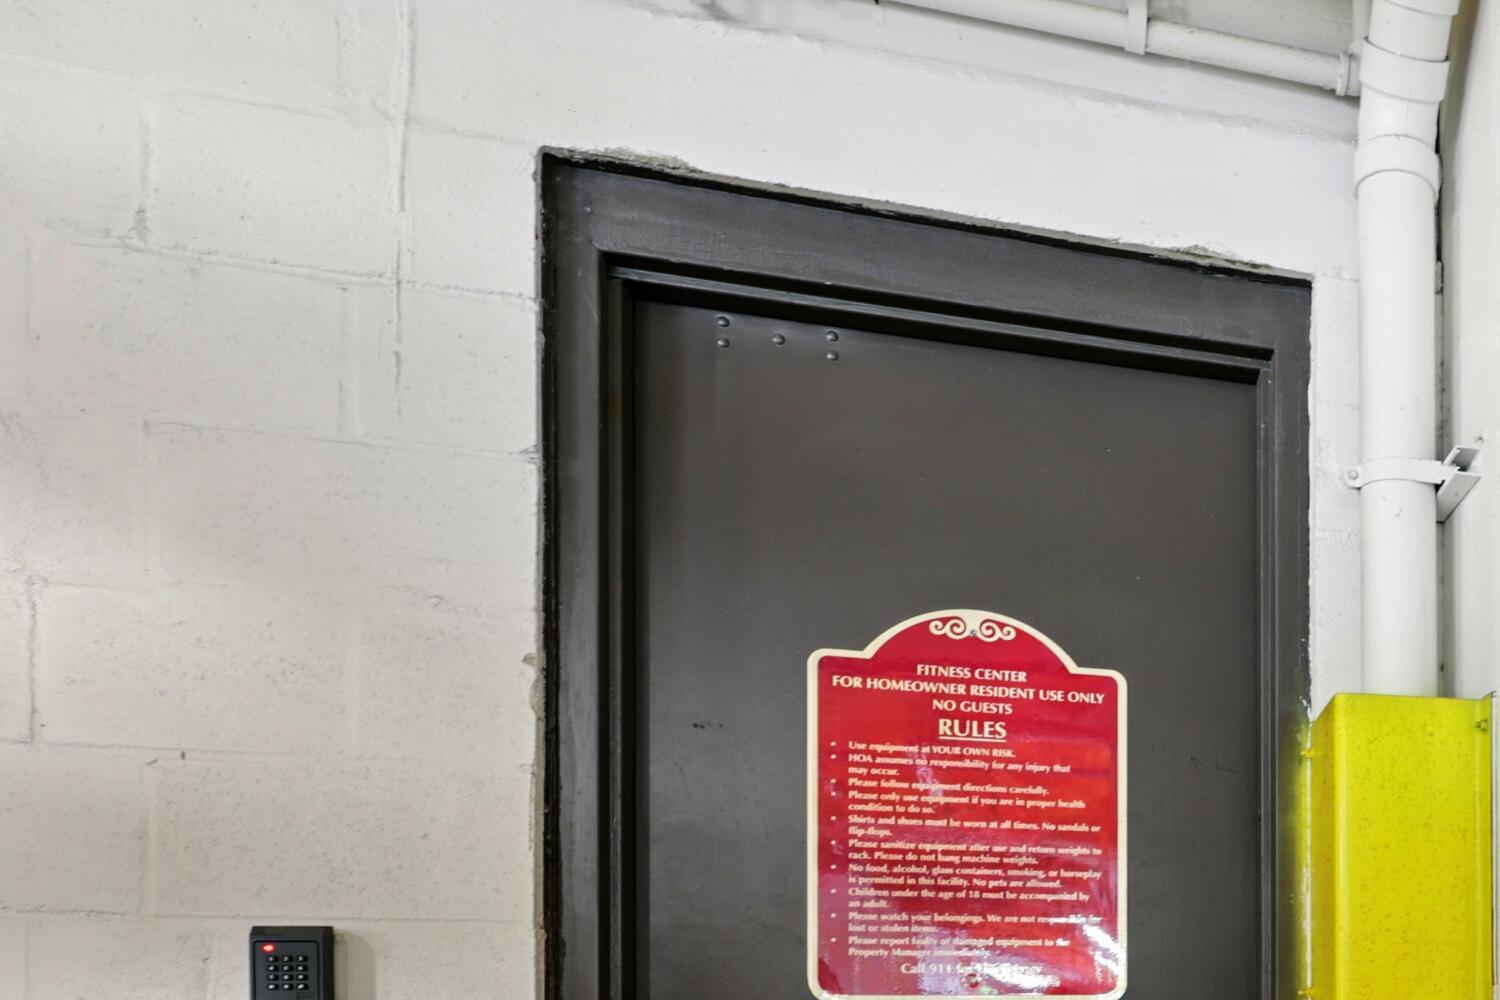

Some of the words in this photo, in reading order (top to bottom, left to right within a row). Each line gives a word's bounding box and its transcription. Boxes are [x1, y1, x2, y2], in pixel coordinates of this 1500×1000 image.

[917, 664, 971, 679] FITNESS
[975, 668, 1027, 682] CENTER
[832, 675, 863, 688] FOR
[866, 678, 966, 695] HOMEOWNER
[970, 684, 1035, 700] RESIDENT
[1040, 689, 1064, 701] USE
[1067, 691, 1104, 704] ONLY
[932, 700, 956, 712] NO
[960, 701, 1012, 715] GUESTS
[939, 719, 1007, 739] RULES
[848, 741, 866, 749] Use
[869, 743, 918, 753] equipment
[932, 746, 961, 754] YOUR
[963, 747, 989, 756] OWN
[992, 748, 1015, 757] RISK.
[848, 754, 872, 762] HOA
[875, 756, 913, 764] assumes
[929, 759, 989, 770] responsibility
[992, 761, 1004, 769] for
[1007, 763, 1023, 772] any
[1025, 762, 1050, 773] injury
[1053, 764, 1070, 772] that
[848, 768, 867, 776] may
[848, 778, 878, 786] Please
[881, 779, 909, 788] follow
[912, 782, 961, 791] equipment
[962, 783, 1006, 792] directions
[848, 791, 878, 799] Please
[880, 792, 899, 802] only
[921, 794, 969, 804] equipment
[980, 798, 996, 806] you
[1016, 798, 1024, 806] in
[1026, 800, 1056, 808] proper
[1058, 800, 1085, 808] health
[848, 803, 893, 811] condition
[848, 815, 875, 824] Shirts
[877, 816, 895, 824] and
[898, 817, 922, 825] shoes
[925, 818, 947, 826] must
[1000, 820, 1011, 828] all
[1042, 822, 1056, 830] No
[1058, 823, 1089, 831] sandals
[848, 839, 878, 848] Please
[880, 841, 916, 849] sanitize
[918, 842, 966, 852] equipment
[1009, 845, 1026, 853] and
[1058, 846, 1090, 855] weights
[848, 851, 871, 859] rack.
[874, 852, 902, 860] Please
[905, 852, 918, 860] do
[938, 853, 960, 864] hang
[962, 855, 999, 863] machine
[866, 864, 890, 873] food,
[932, 865, 953, 875] glass
[1060, 869, 1102, 879] horseplay
[848, 875, 856, 883] is
[859, 876, 904, 886] permitted
[907, 876, 916, 884] in
[988, 880, 1007, 888] pets
[848, 887, 889, 896] Children
[921, 889, 935, 897] the
[938, 892, 953, 900] age
[956, 890, 966, 898] of
[1006, 891, 1017, 899] be
[1079, 893, 1089, 902] by
[848, 912, 878, 920] Please
[881, 912, 909, 920] watch
[911, 914, 932, 922] your
[987, 914, 1002, 922] We
[881, 924, 908, 932] stolen
[848, 936, 878, 944] Please
[880, 937, 909, 946] report
[996, 937, 1042, 948] equipment
[1056, 938, 1070, 946] the
[848, 948, 889, 958] Property
[901, 962, 926, 974] Call
